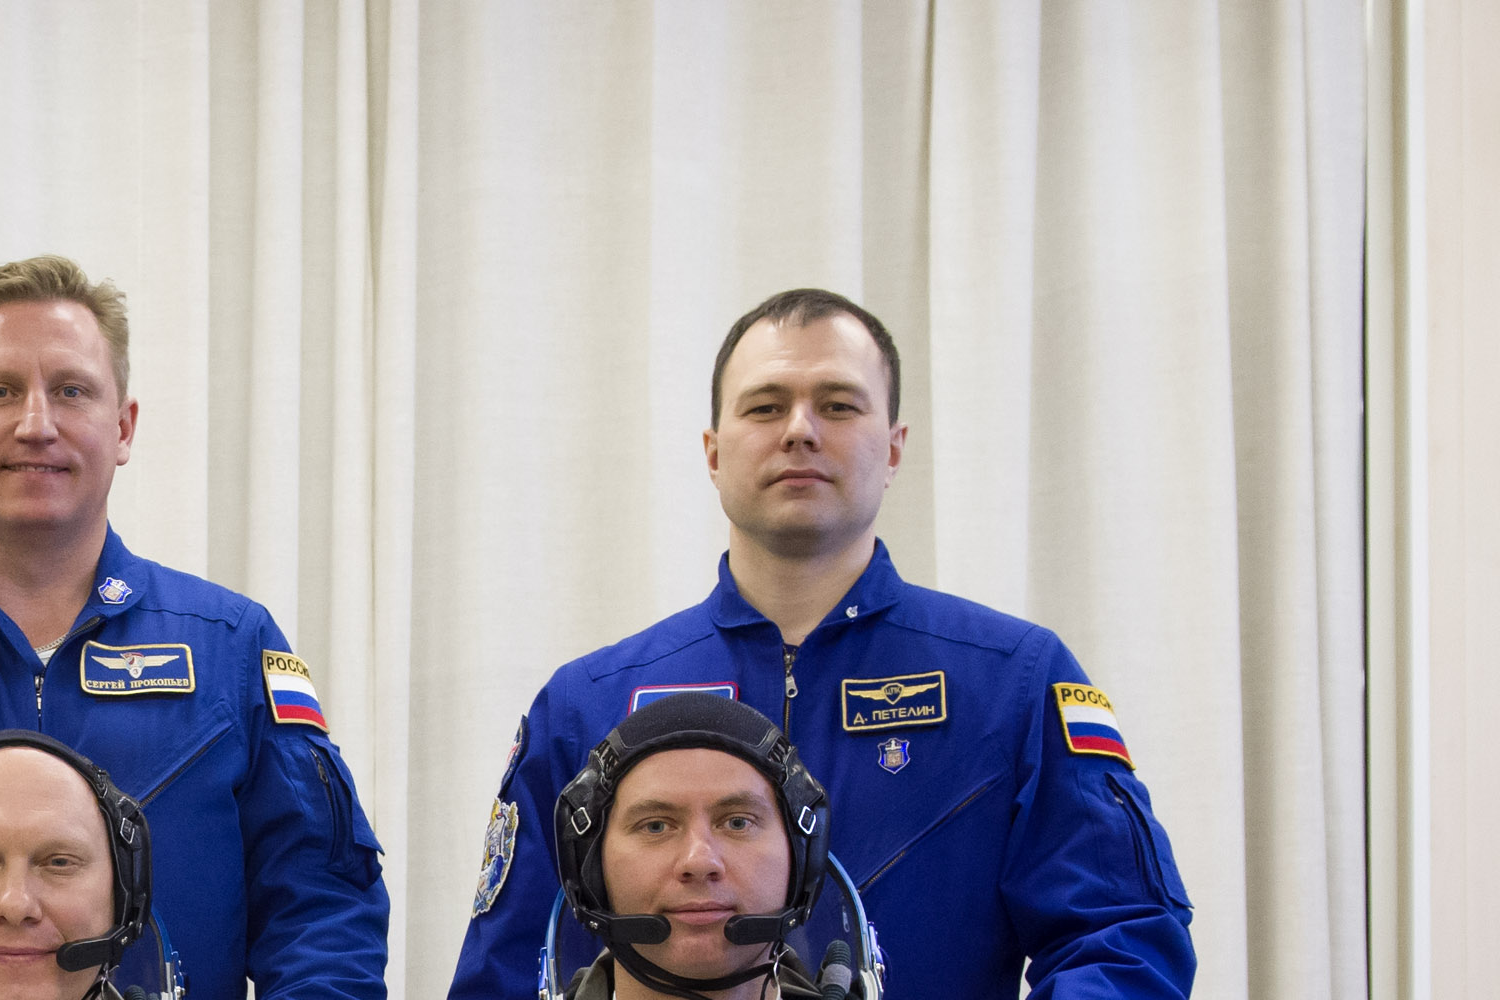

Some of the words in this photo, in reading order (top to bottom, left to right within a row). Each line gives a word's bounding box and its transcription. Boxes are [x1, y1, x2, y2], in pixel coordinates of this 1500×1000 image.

[86, 679, 125, 689] СЕРГЕЙ
[130, 678, 189, 689] ПРОКОПЬЕВ
[872, 705, 935, 721] ПЕТЕЛИН
